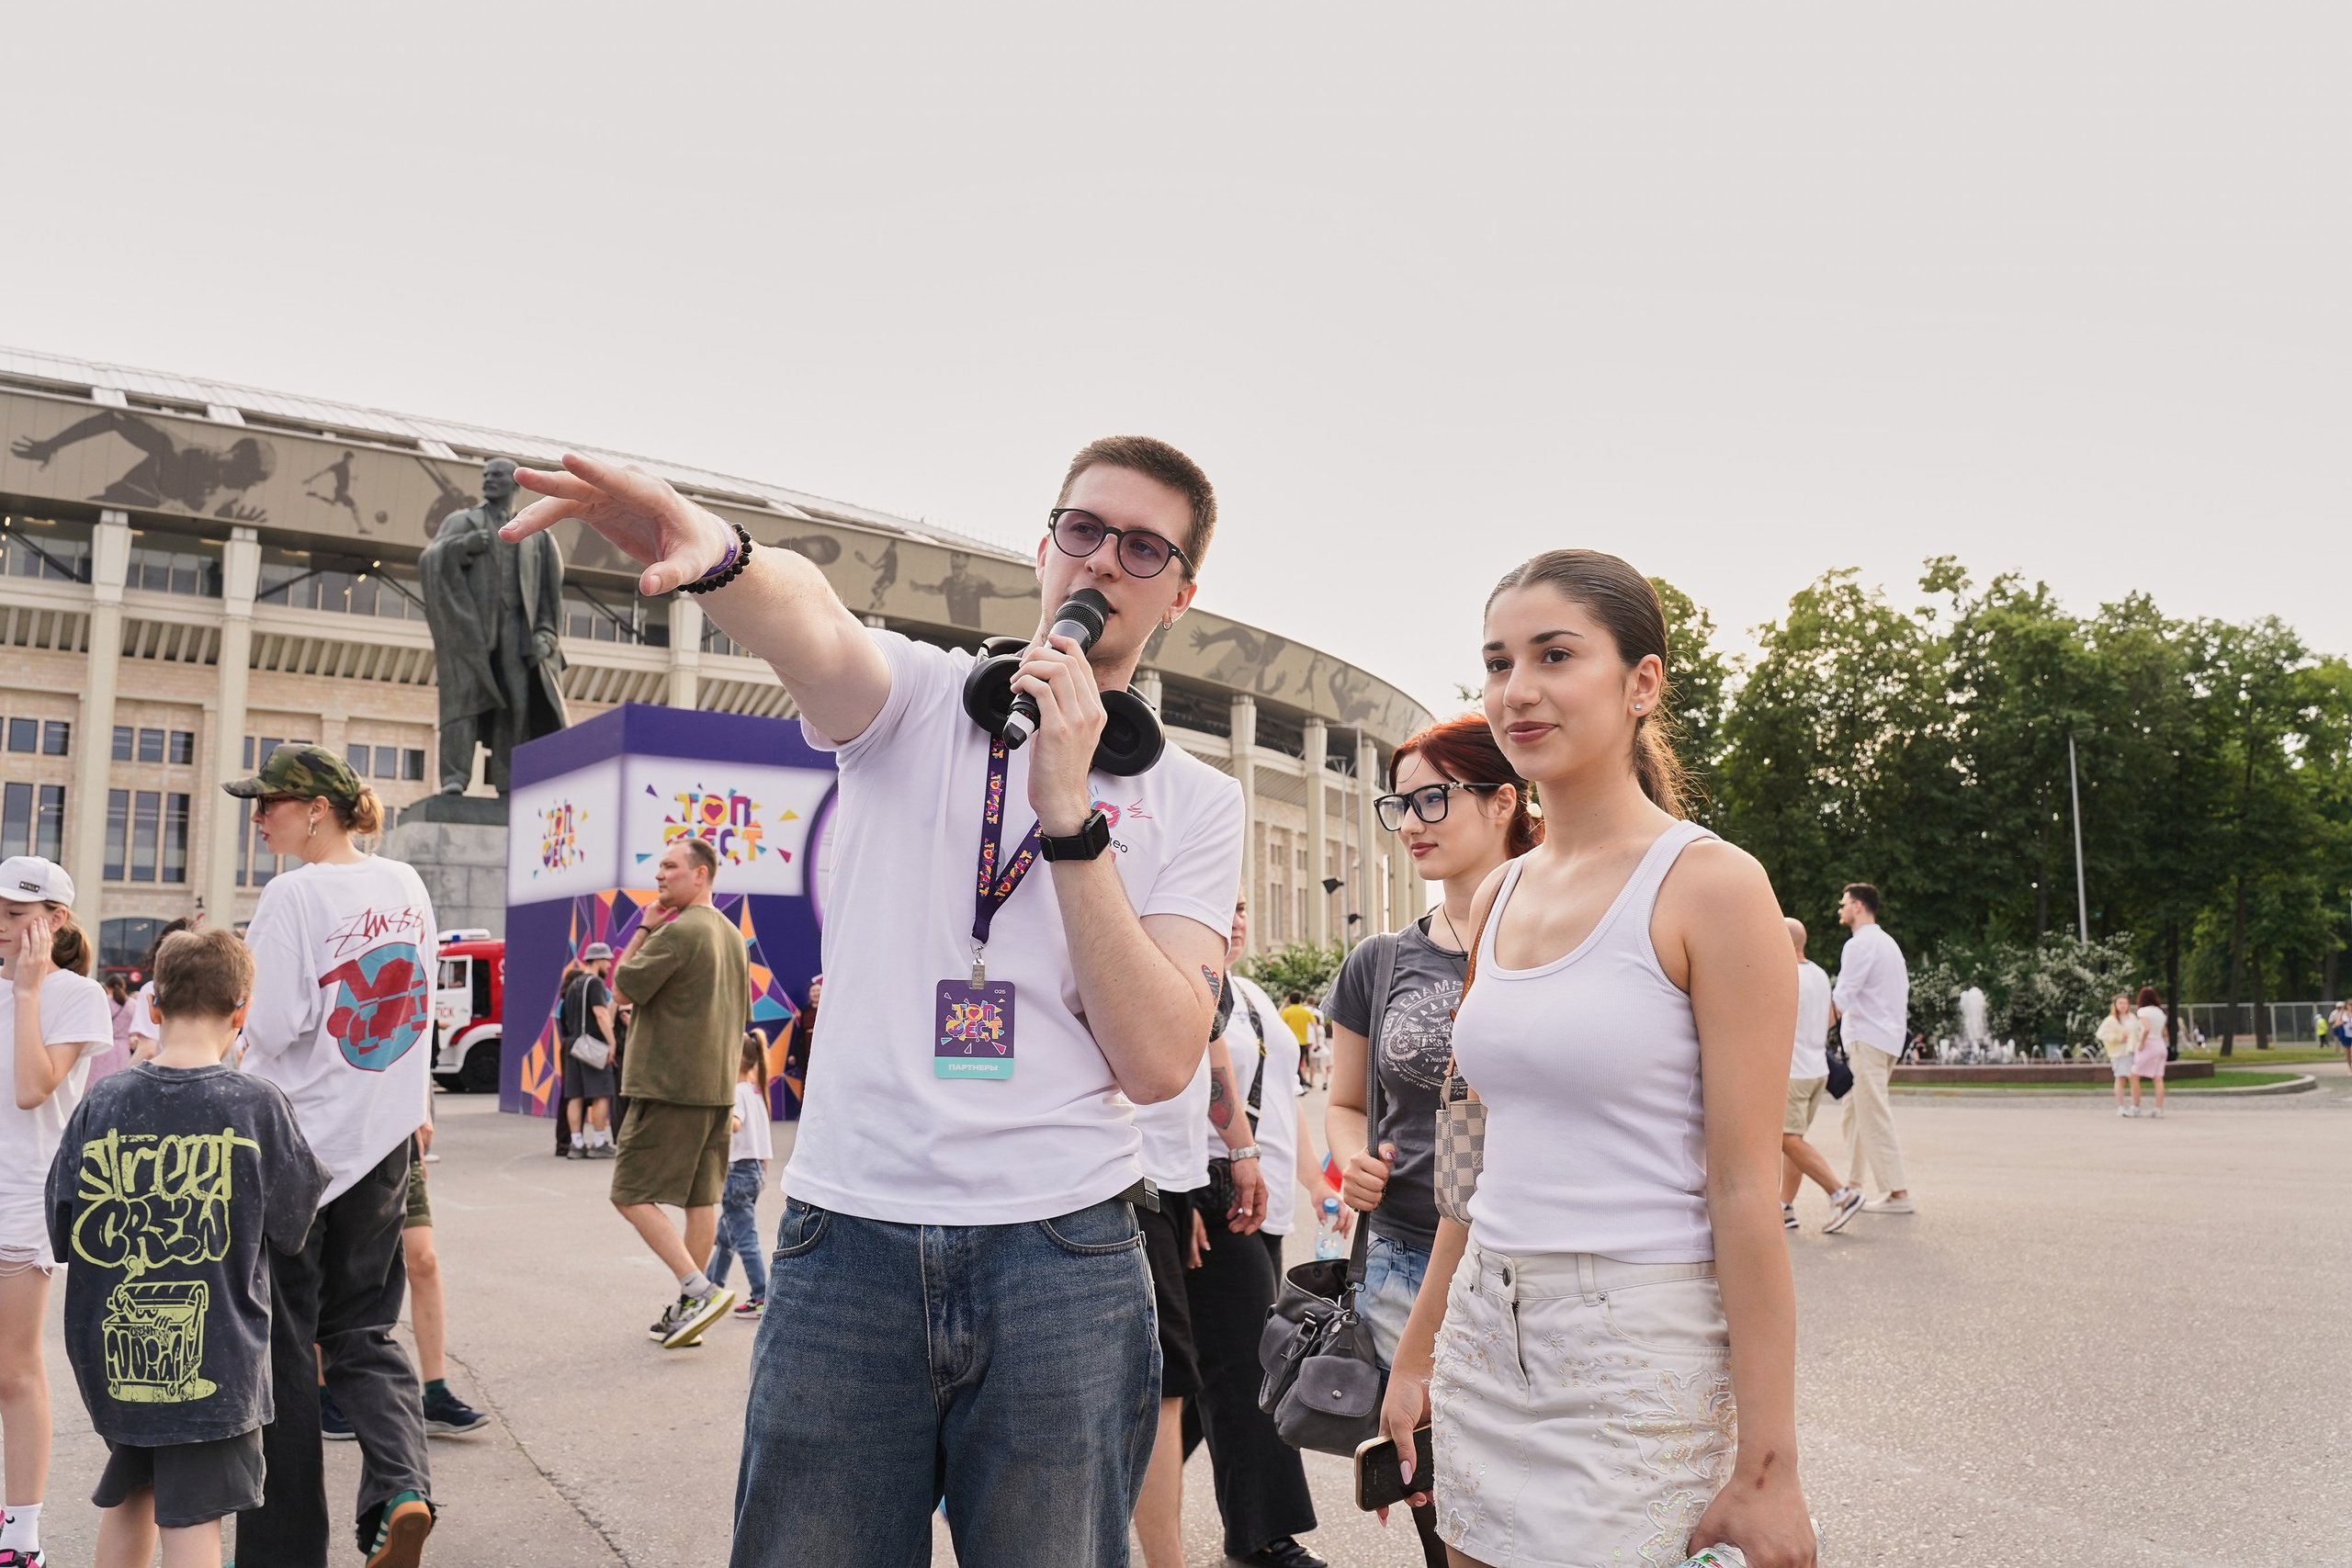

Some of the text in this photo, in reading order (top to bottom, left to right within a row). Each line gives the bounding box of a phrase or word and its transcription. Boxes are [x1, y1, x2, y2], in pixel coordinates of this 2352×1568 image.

[674, 793, 752, 827] ТОП
[952, 1003, 997, 1021] ТОП
[946, 1018, 1002, 1040] ФЕСТ
